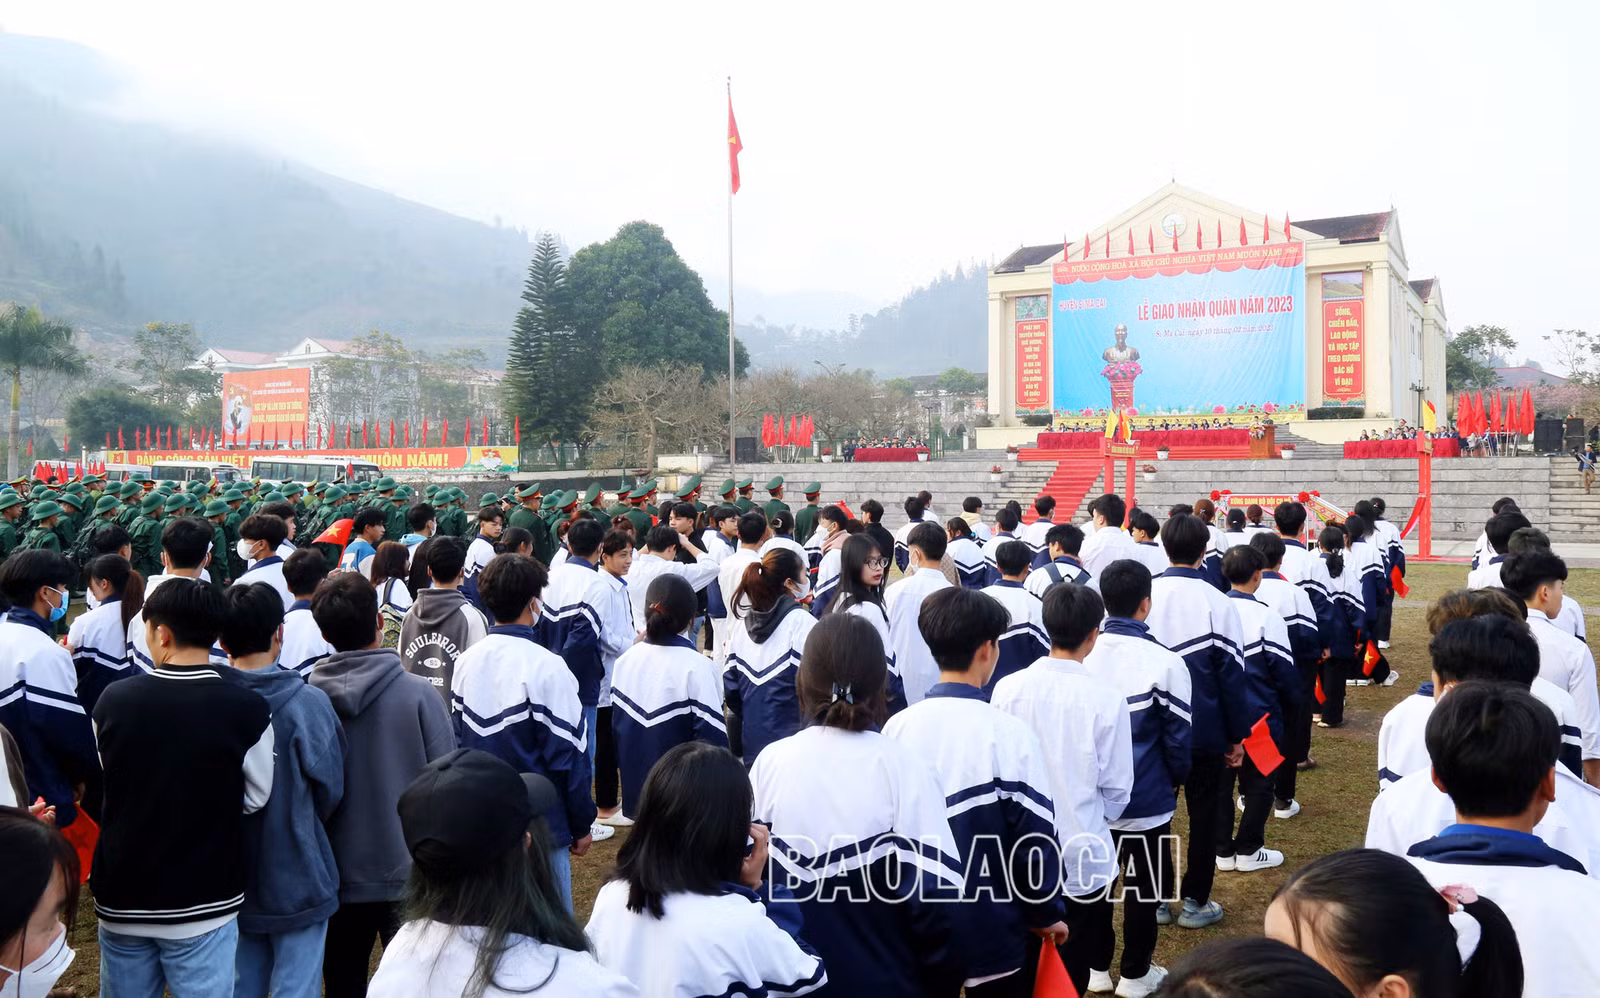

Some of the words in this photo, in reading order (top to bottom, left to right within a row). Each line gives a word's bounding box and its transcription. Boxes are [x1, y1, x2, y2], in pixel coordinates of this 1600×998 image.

[1072, 263, 1090, 272] NƯỚC
[1091, 262, 1110, 272] CỘNG
[1141, 258, 1155, 268] HỘI
[1156, 256, 1170, 266] CHỦ
[1172, 254, 1196, 264] NGHĨA
[1198, 253, 1216, 262] VIỆT
[1218, 252, 1236, 260] NAM
[1237, 250, 1260, 258] MUÔN
[1086, 300, 1094, 308] MA
[1096, 298, 1106, 308] CAI
[1138, 298, 1149, 320] LỄ
[1152, 303, 1175, 320] GIAO
[1177, 299, 1206, 320] NHẬN
[1209, 297, 1237, 318] QUÂN
[1239, 295, 1264, 314] NĂM
[1267, 296, 1293, 313] 2023
[1330, 332, 1341, 340] LAO
[1328, 342, 1336, 350] VÀ
[1349, 341, 1360, 352] TẬP
[406, 451, 448, 466] NĂM!
